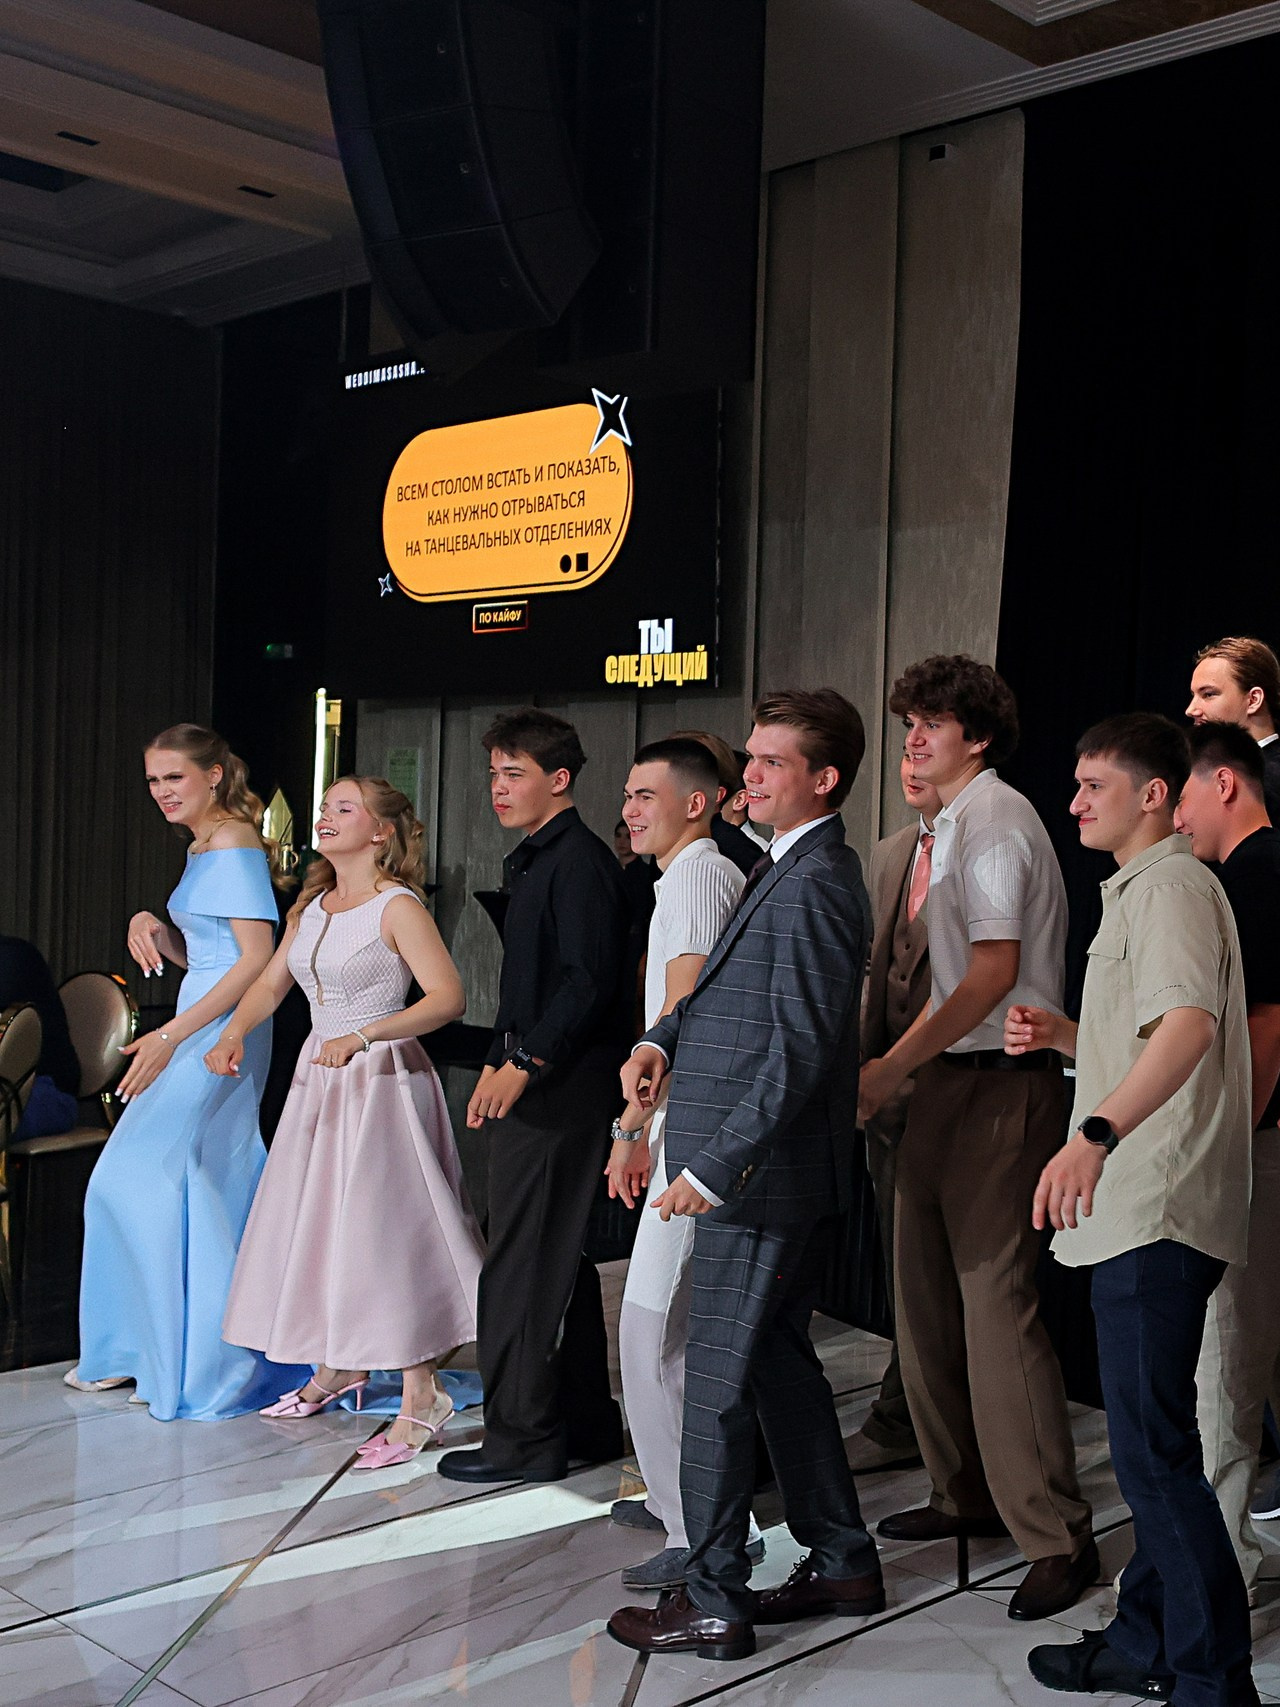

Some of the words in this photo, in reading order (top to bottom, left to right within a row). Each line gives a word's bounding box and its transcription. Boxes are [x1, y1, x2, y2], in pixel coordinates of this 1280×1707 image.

[344, 361, 426, 390] WEDDIMASASHA.
[397, 482, 428, 502] ВСЕМ
[431, 475, 483, 497] СТОЛОМ
[487, 468, 531, 490] ВСТАТЬ
[534, 465, 543, 483] И
[547, 455, 621, 481] ПОКАЗАТЬ,
[427, 508, 450, 526] КАК
[453, 502, 499, 523] НУЖНО
[501, 490, 586, 517] ОТРЫВАТЬСЯ
[405, 541, 422, 557] НА
[424, 528, 521, 555] ТАНЦЕВАЛЬНЫХ
[524, 518, 612, 546] ОТДЕЛЕНИЯХ
[479, 612, 492, 624] ПО
[492, 608, 522, 623] КАЙФУ
[638, 618, 673, 654] ТЫ
[605, 644, 708, 687] СЛЕДУЩИЙ
